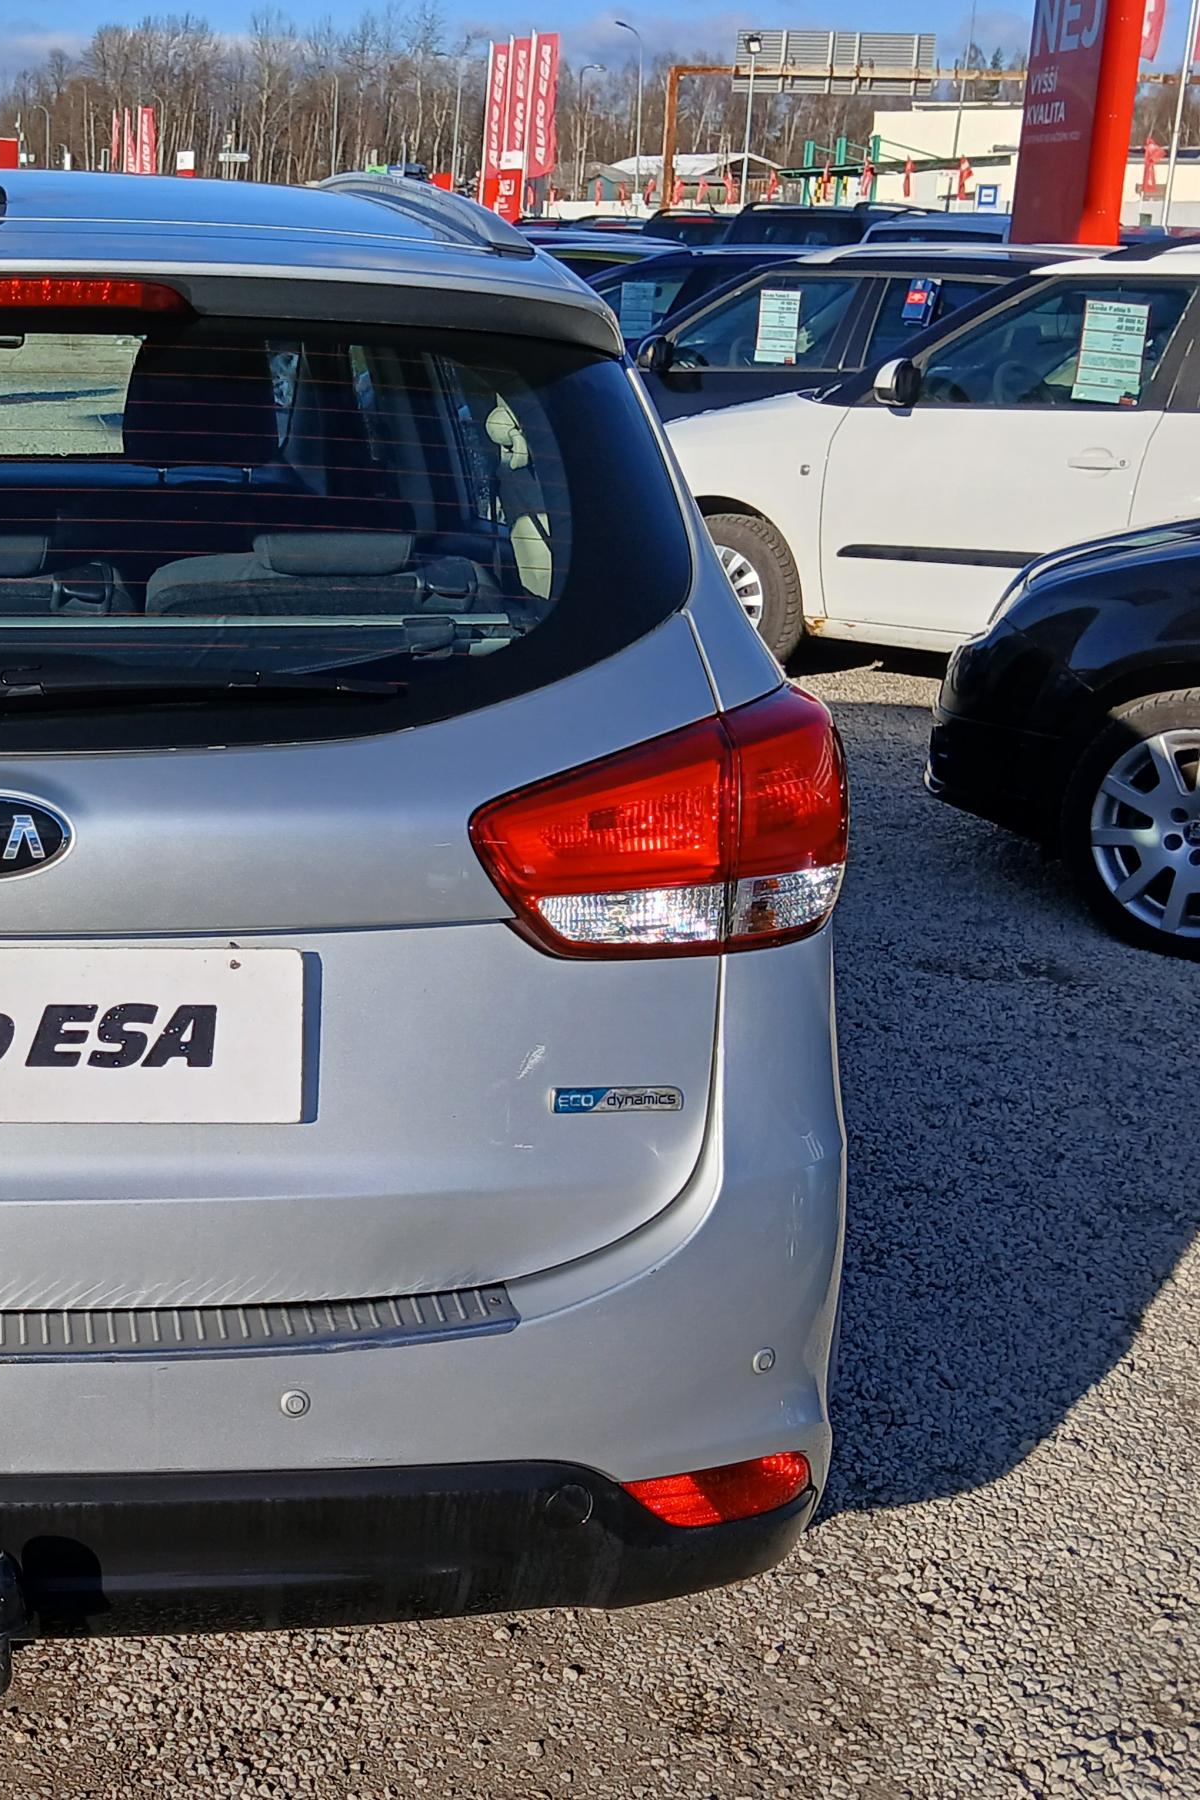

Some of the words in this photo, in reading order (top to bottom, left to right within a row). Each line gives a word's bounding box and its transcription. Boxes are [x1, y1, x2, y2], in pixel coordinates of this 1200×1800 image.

[1033, 0, 1102, 57] NEJ
[1030, 66, 1059, 96] VYŠŠÍ
[1025, 101, 1065, 126] KVALITA
[25, 1003, 217, 1068] ESA
[558, 1094, 594, 1107] ECO
[606, 1092, 677, 1108] dynamics
